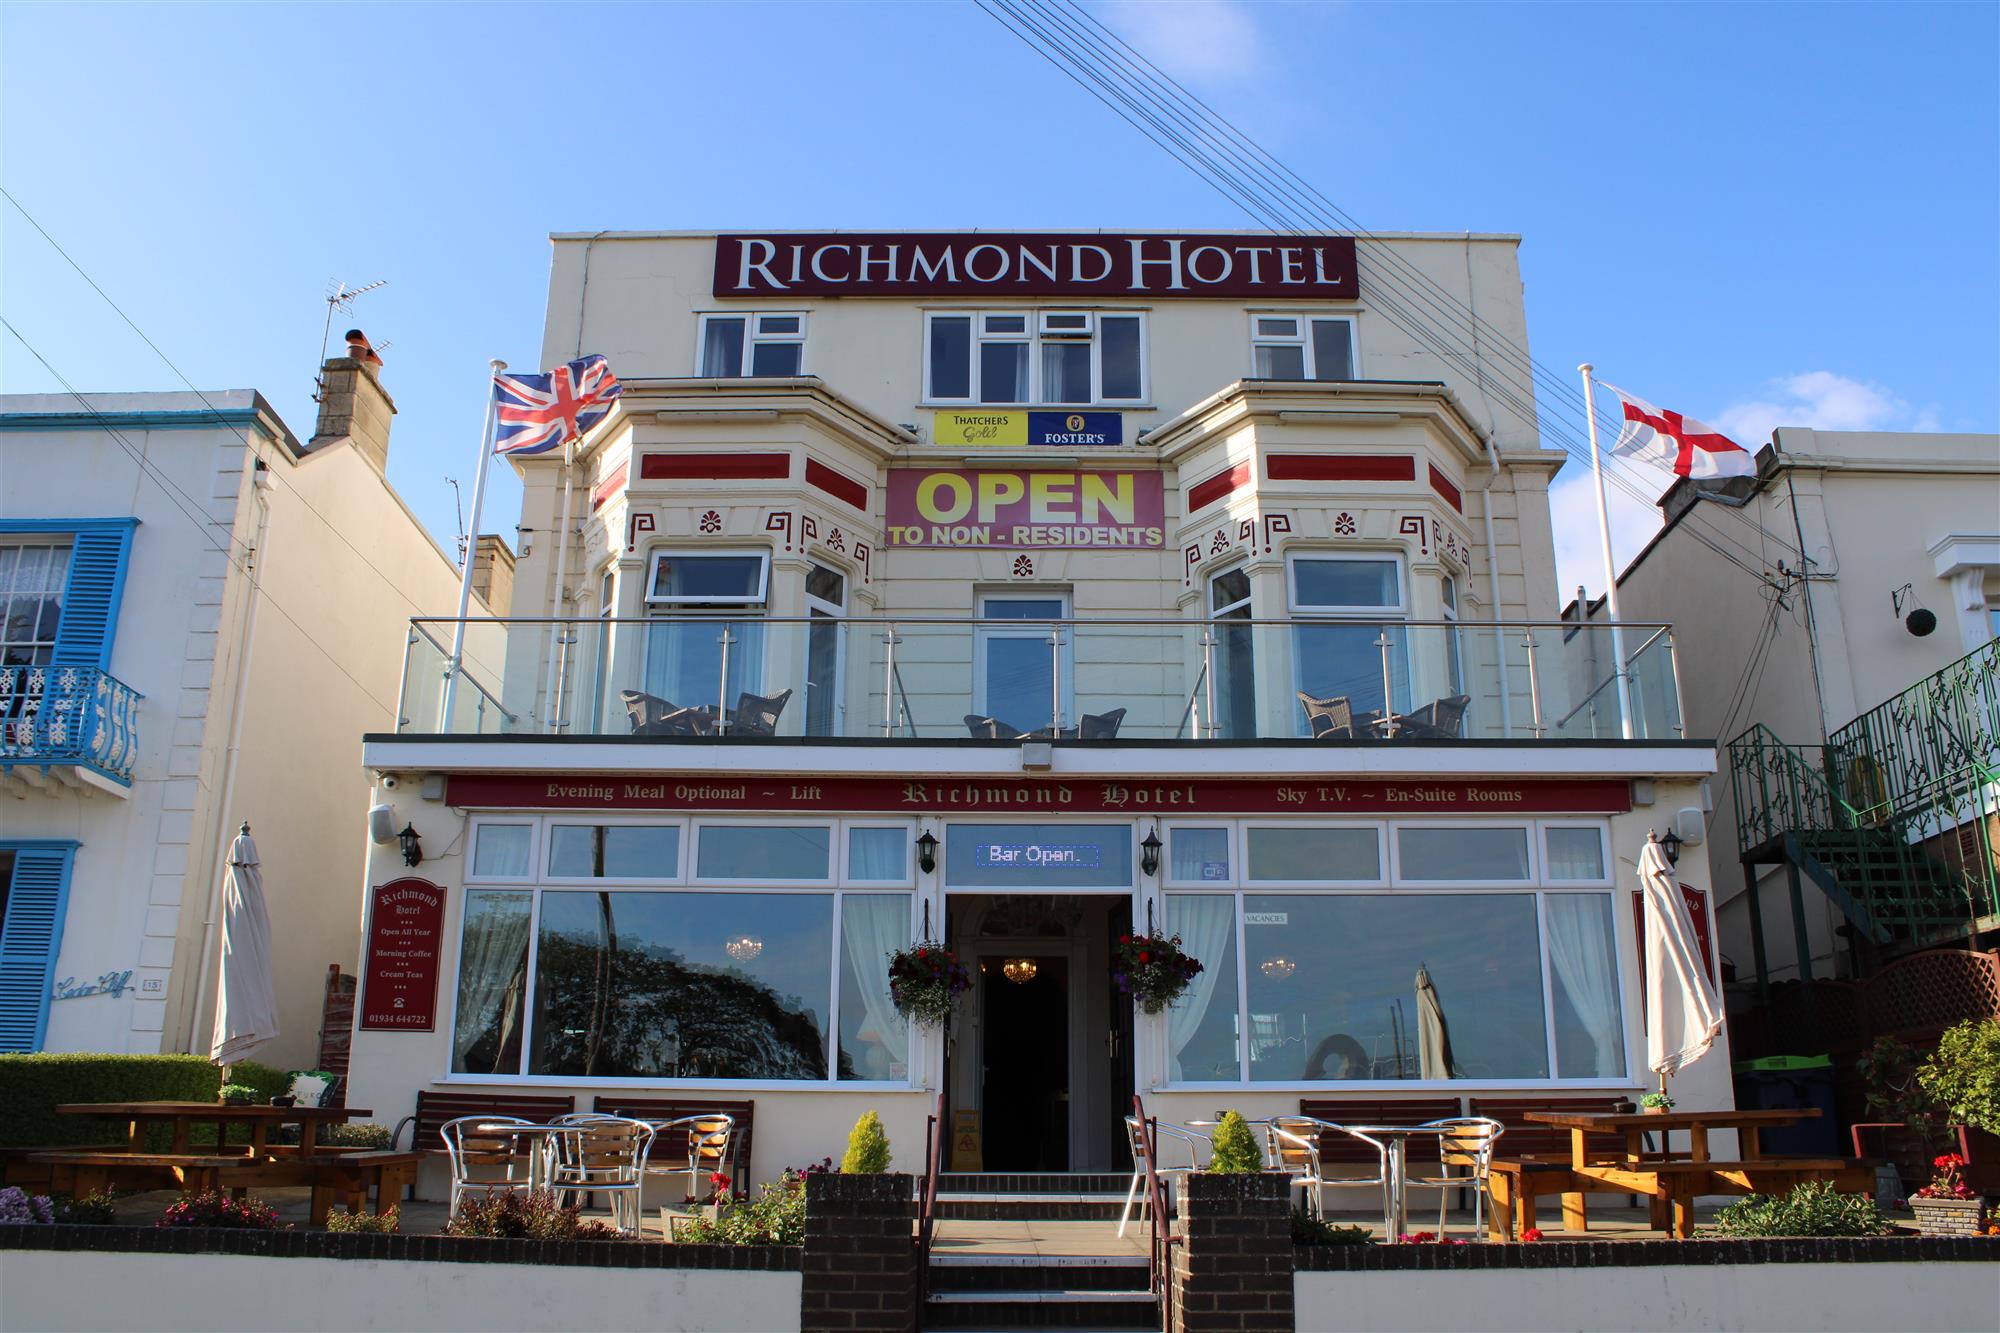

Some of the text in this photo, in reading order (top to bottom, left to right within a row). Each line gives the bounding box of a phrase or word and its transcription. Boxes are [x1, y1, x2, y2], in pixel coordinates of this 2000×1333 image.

[732, 238, 1344, 290] RICHMOND HOTEL
[954, 415, 1009, 426] THATCHERS
[963, 426, 998, 443] Gold
[1045, 433, 1105, 444] FOSTER'S
[915, 472, 1136, 525] OPEN
[886, 525, 927, 546] TO
[930, 525, 991, 546] NON
[1011, 525, 1163, 547] RESIDENTS
[546, 783, 614, 801] Evening
[623, 784, 665, 799] Meal
[674, 785, 746, 801] Optional
[791, 786, 822, 800] Lift
[902, 783, 1196, 807] Richmond Hotel
[1276, 788, 1307, 804] Sky
[1317, 788, 1351, 802] T.V.
[1385, 788, 1456, 802] En-Suite
[1466, 788, 1522, 802] Rooms
[990, 845, 1021, 861] Bar
[380, 889, 438, 907] Richmond
[396, 905, 420, 915] Hotel
[380, 928, 400, 936] Open
[376, 949, 432, 958] Morning Coffee
[369, 1014, 426, 1023] 01934 644722
